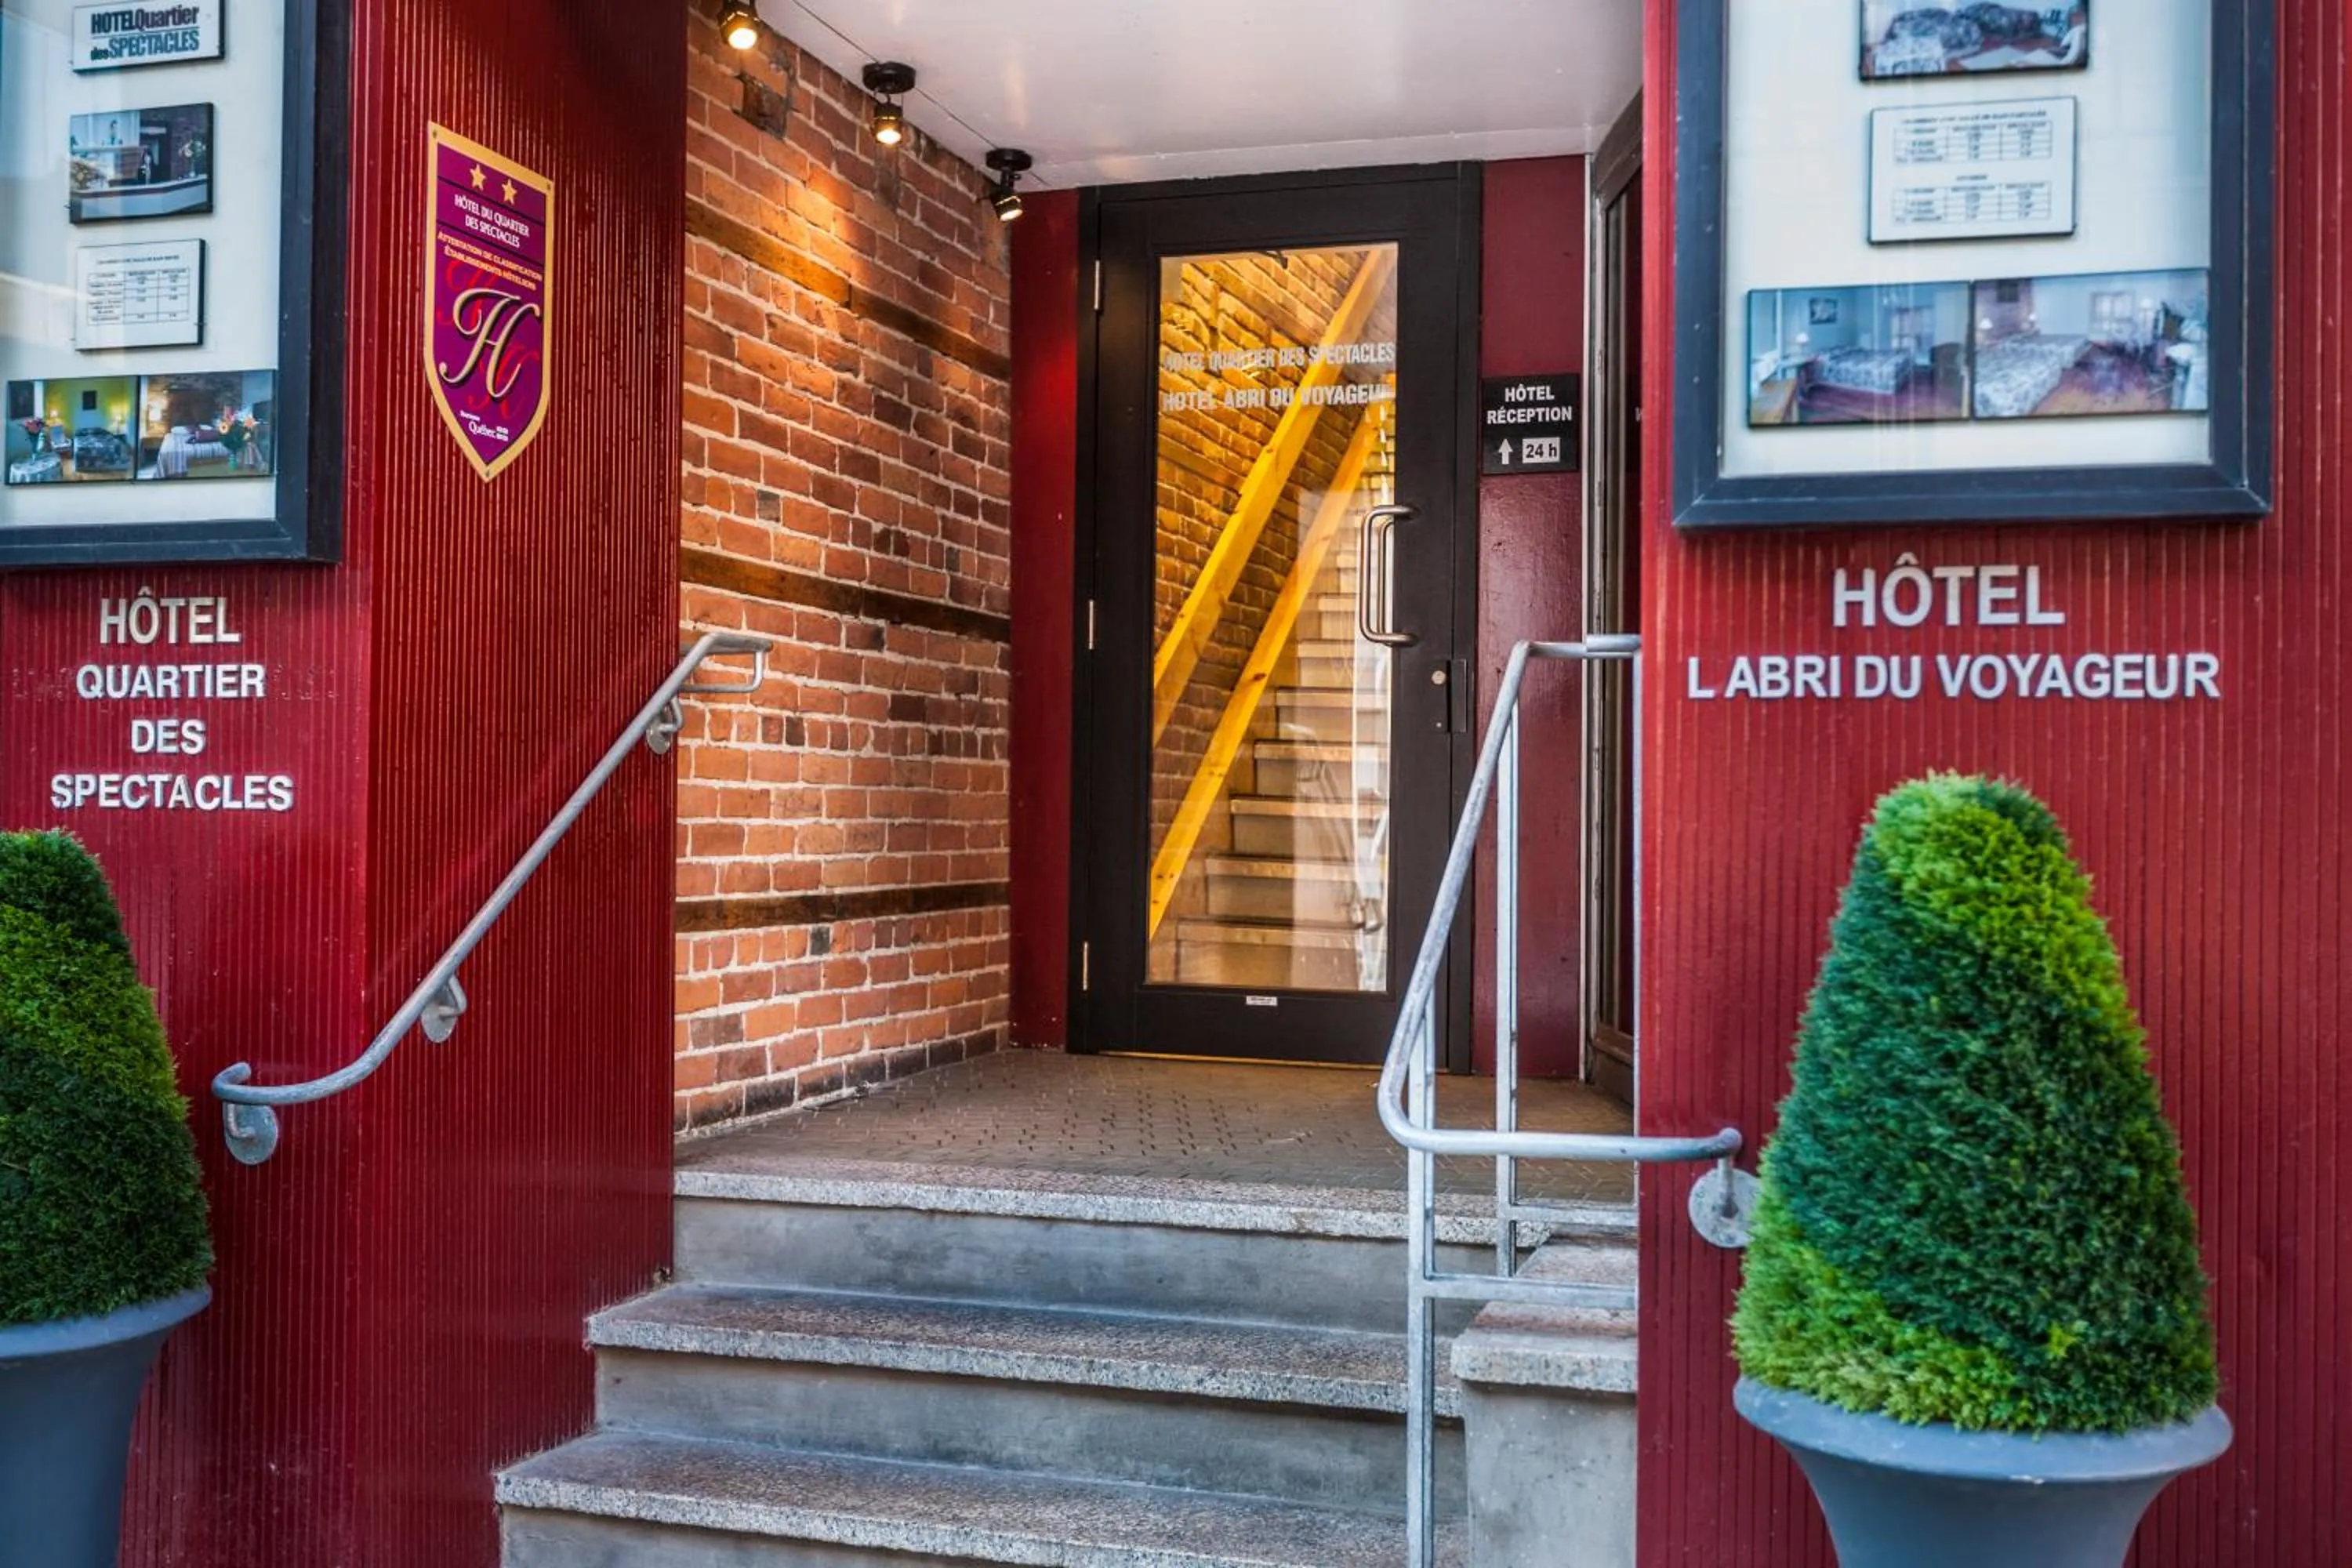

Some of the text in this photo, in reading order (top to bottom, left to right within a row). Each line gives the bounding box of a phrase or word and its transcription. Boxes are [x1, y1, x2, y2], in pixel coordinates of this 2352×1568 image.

[465, 214, 520, 248] DES SPECTACLES
[481, 205, 492, 220] DU
[494, 212, 530, 237] QUARTIER
[1209, 348, 1276, 372] QUARTIER
[1279, 346, 1305, 366] DES
[1308, 341, 1395, 364] SPECTACLES
[1224, 388, 1266, 408] ABRI
[1269, 387, 1294, 407] DU
[1301, 383, 1396, 405] VOYAGEU
[1504, 383, 1555, 402] HÔTEL
[1487, 405, 1572, 424] RÉCEPTION
[1526, 443, 1557, 459] 24 h
[1833, 552, 2064, 626] HÔTEL
[100, 586, 241, 644] HÔTEL
[76, 663, 267, 699] QUARTIER
[1688, 652, 2220, 699] L ABRI DU VOYAGEUR
[130, 718, 206, 755] DES
[51, 773, 295, 811] SPECTACLES
